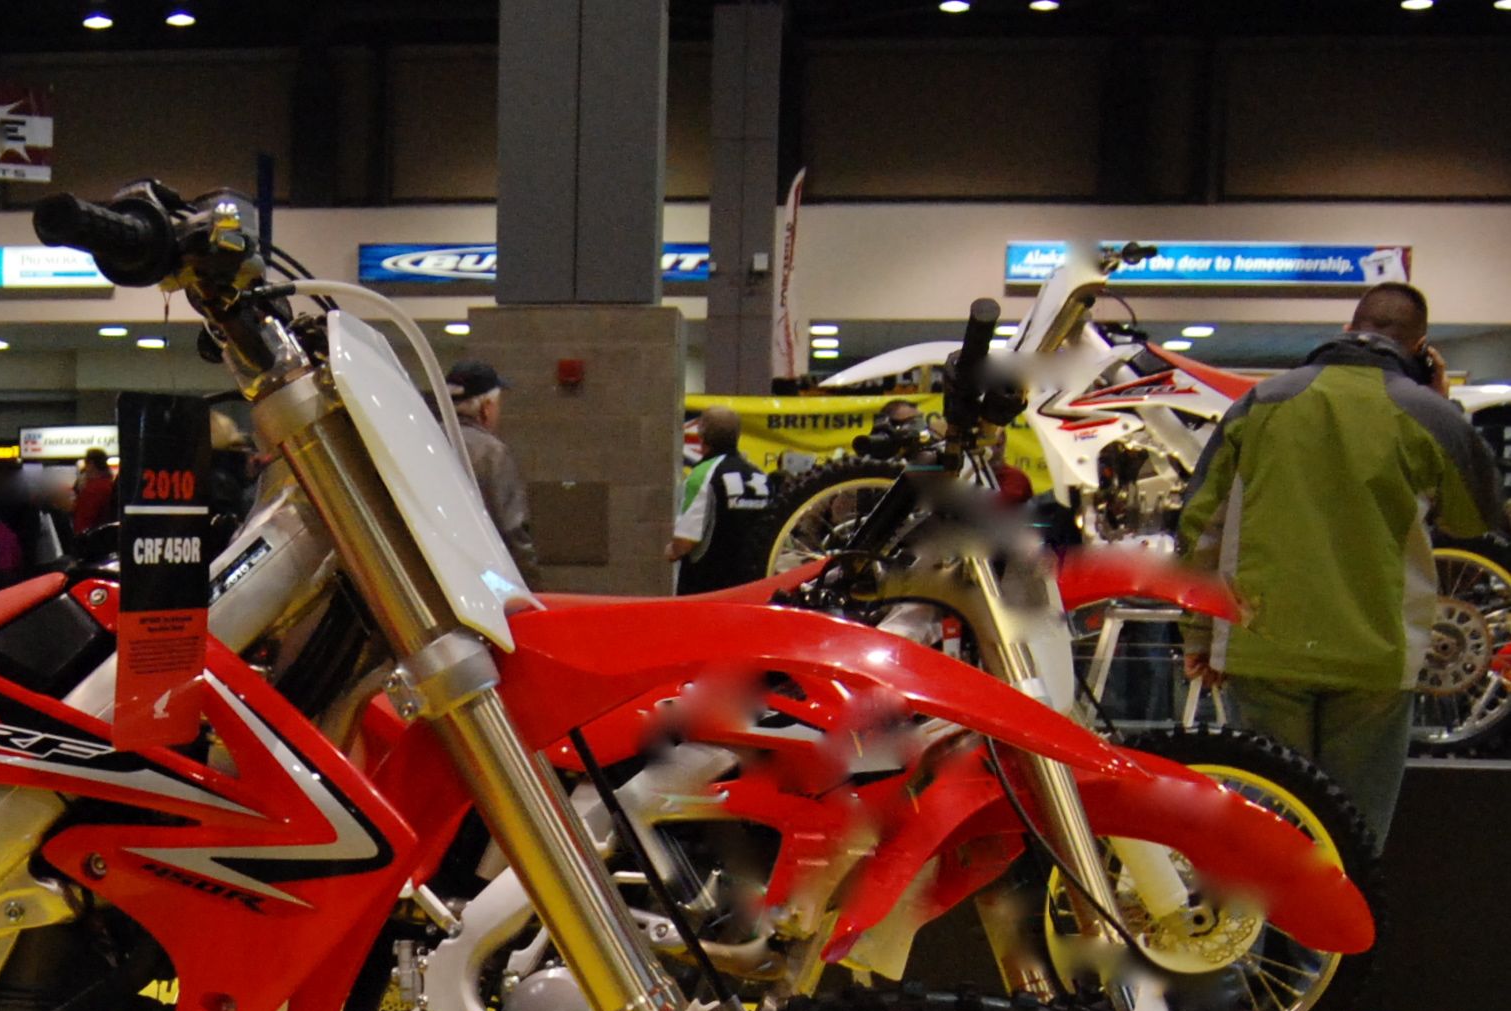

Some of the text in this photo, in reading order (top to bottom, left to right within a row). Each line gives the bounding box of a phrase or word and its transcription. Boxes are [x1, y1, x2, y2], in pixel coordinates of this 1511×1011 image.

[1149, 255, 1175, 272] the
[1177, 255, 1212, 272] door
[1214, 255, 1231, 272] to
[767, 413, 864, 430] BRITISH
[141, 469, 196, 500] 2010
